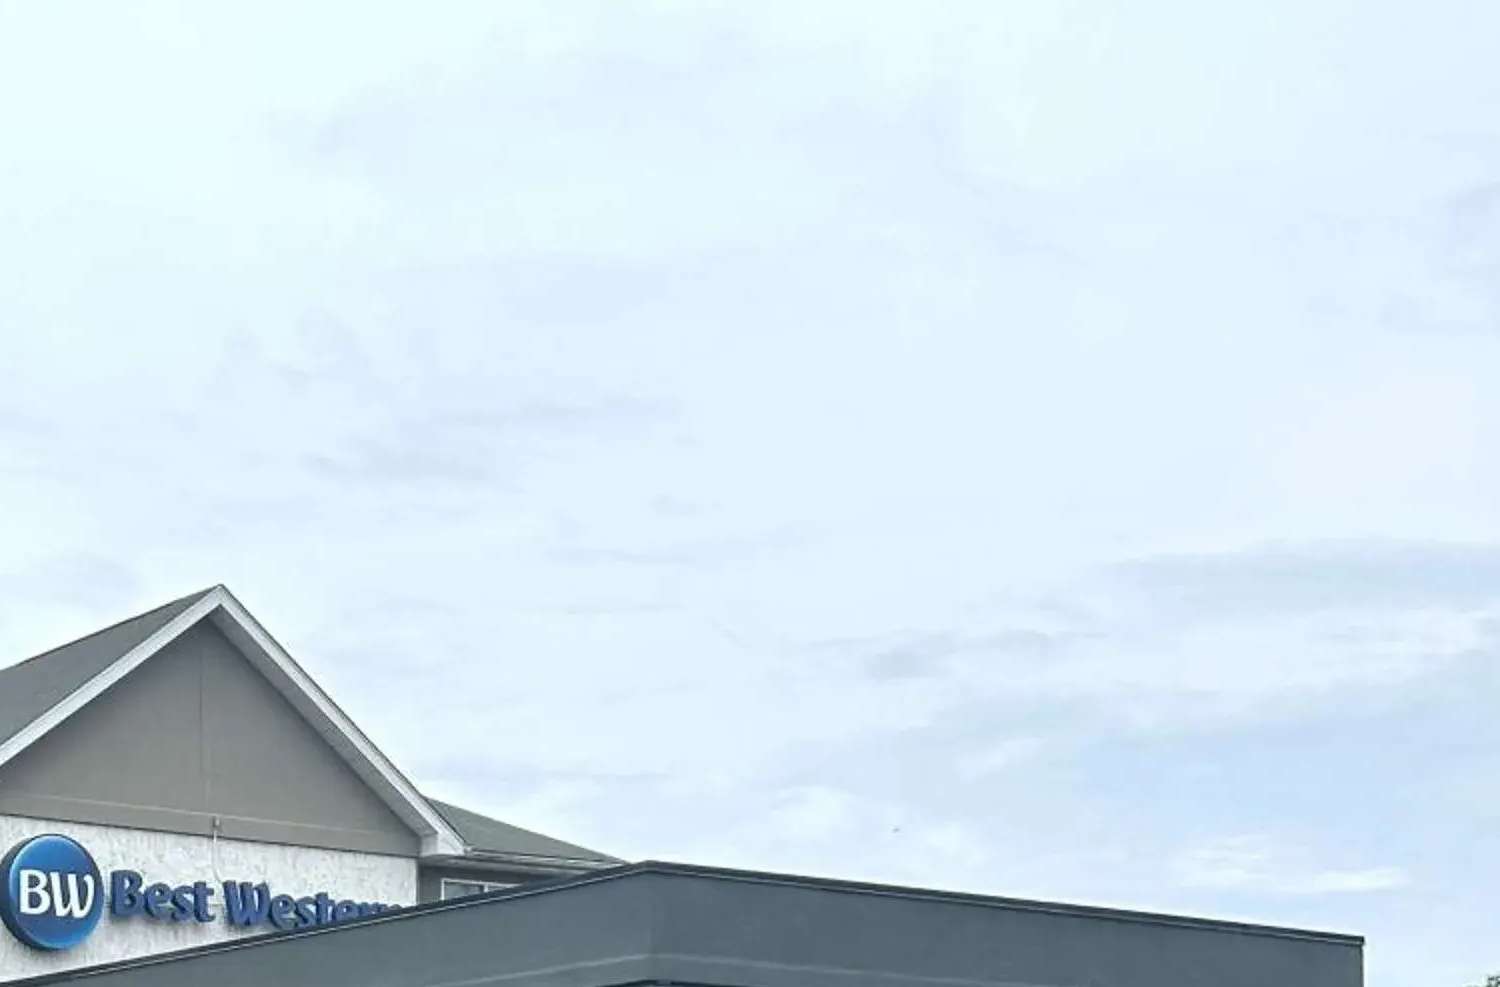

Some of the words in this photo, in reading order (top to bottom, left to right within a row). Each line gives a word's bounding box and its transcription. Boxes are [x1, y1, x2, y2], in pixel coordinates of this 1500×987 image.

[19, 869, 94, 918] BW
[110, 870, 215, 922] Best
[222, 880, 403, 930] Weste
